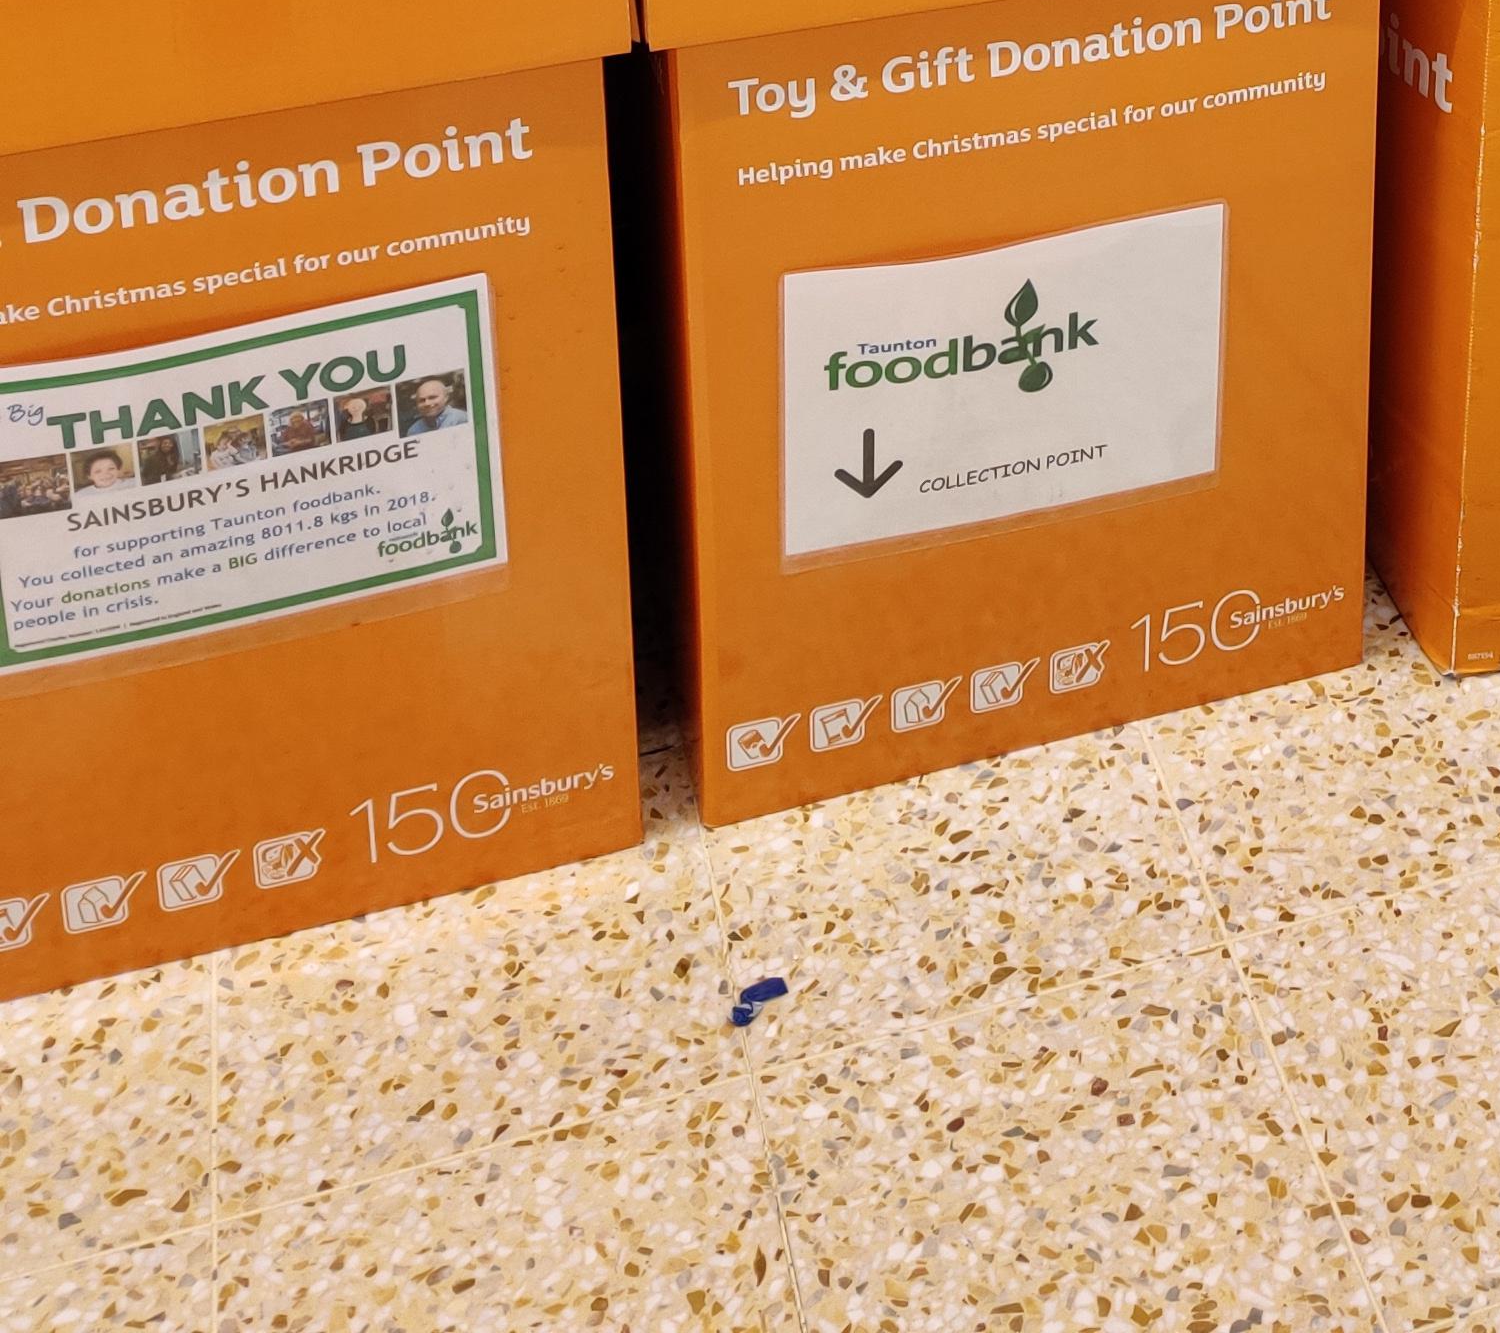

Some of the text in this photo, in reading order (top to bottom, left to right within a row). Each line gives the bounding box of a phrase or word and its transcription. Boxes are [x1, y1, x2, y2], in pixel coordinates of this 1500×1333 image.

[727, 75, 818, 120] Toy
[829, 63, 870, 103] &
[880, 44, 975, 94] Gift
[986, 9, 1203, 81] Donation
[737, 67, 1328, 187] Helping make Christmas special for our community
[17, 116, 534, 245] Donation Point
[46, 213, 533, 319] Christmas special for our community
[823, 310, 1100, 392] foodbank
[856, 334, 938, 356] Taunton
[46, 343, 407, 450] THANK YOU
[66, 438, 421, 533] SAINSBURY'S HANKRIDGE
[918, 443, 1109, 495] COLLECTION POINT
[10, 594, 56, 614] Your
[60, 575, 152, 606] donations
[156, 564, 207, 587] make
[211, 560, 223, 574] a
[227, 551, 259, 571] BIG
[263, 530, 357, 562] difference
[362, 525, 381, 540] to
[386, 511, 428, 534] local
[18, 490, 438, 590] You collected an amazing 8011.8 kgs in 2018.
[73, 483, 382, 560] for supporting Taunton foodbank.
[13, 608, 78, 633] people
[82, 603, 100, 619] in
[105, 593, 160, 615] crisis.
[1130, 584, 1345, 673] 150 Sainsbury's
[349, 762, 615, 864] 150 Sainsbury's
